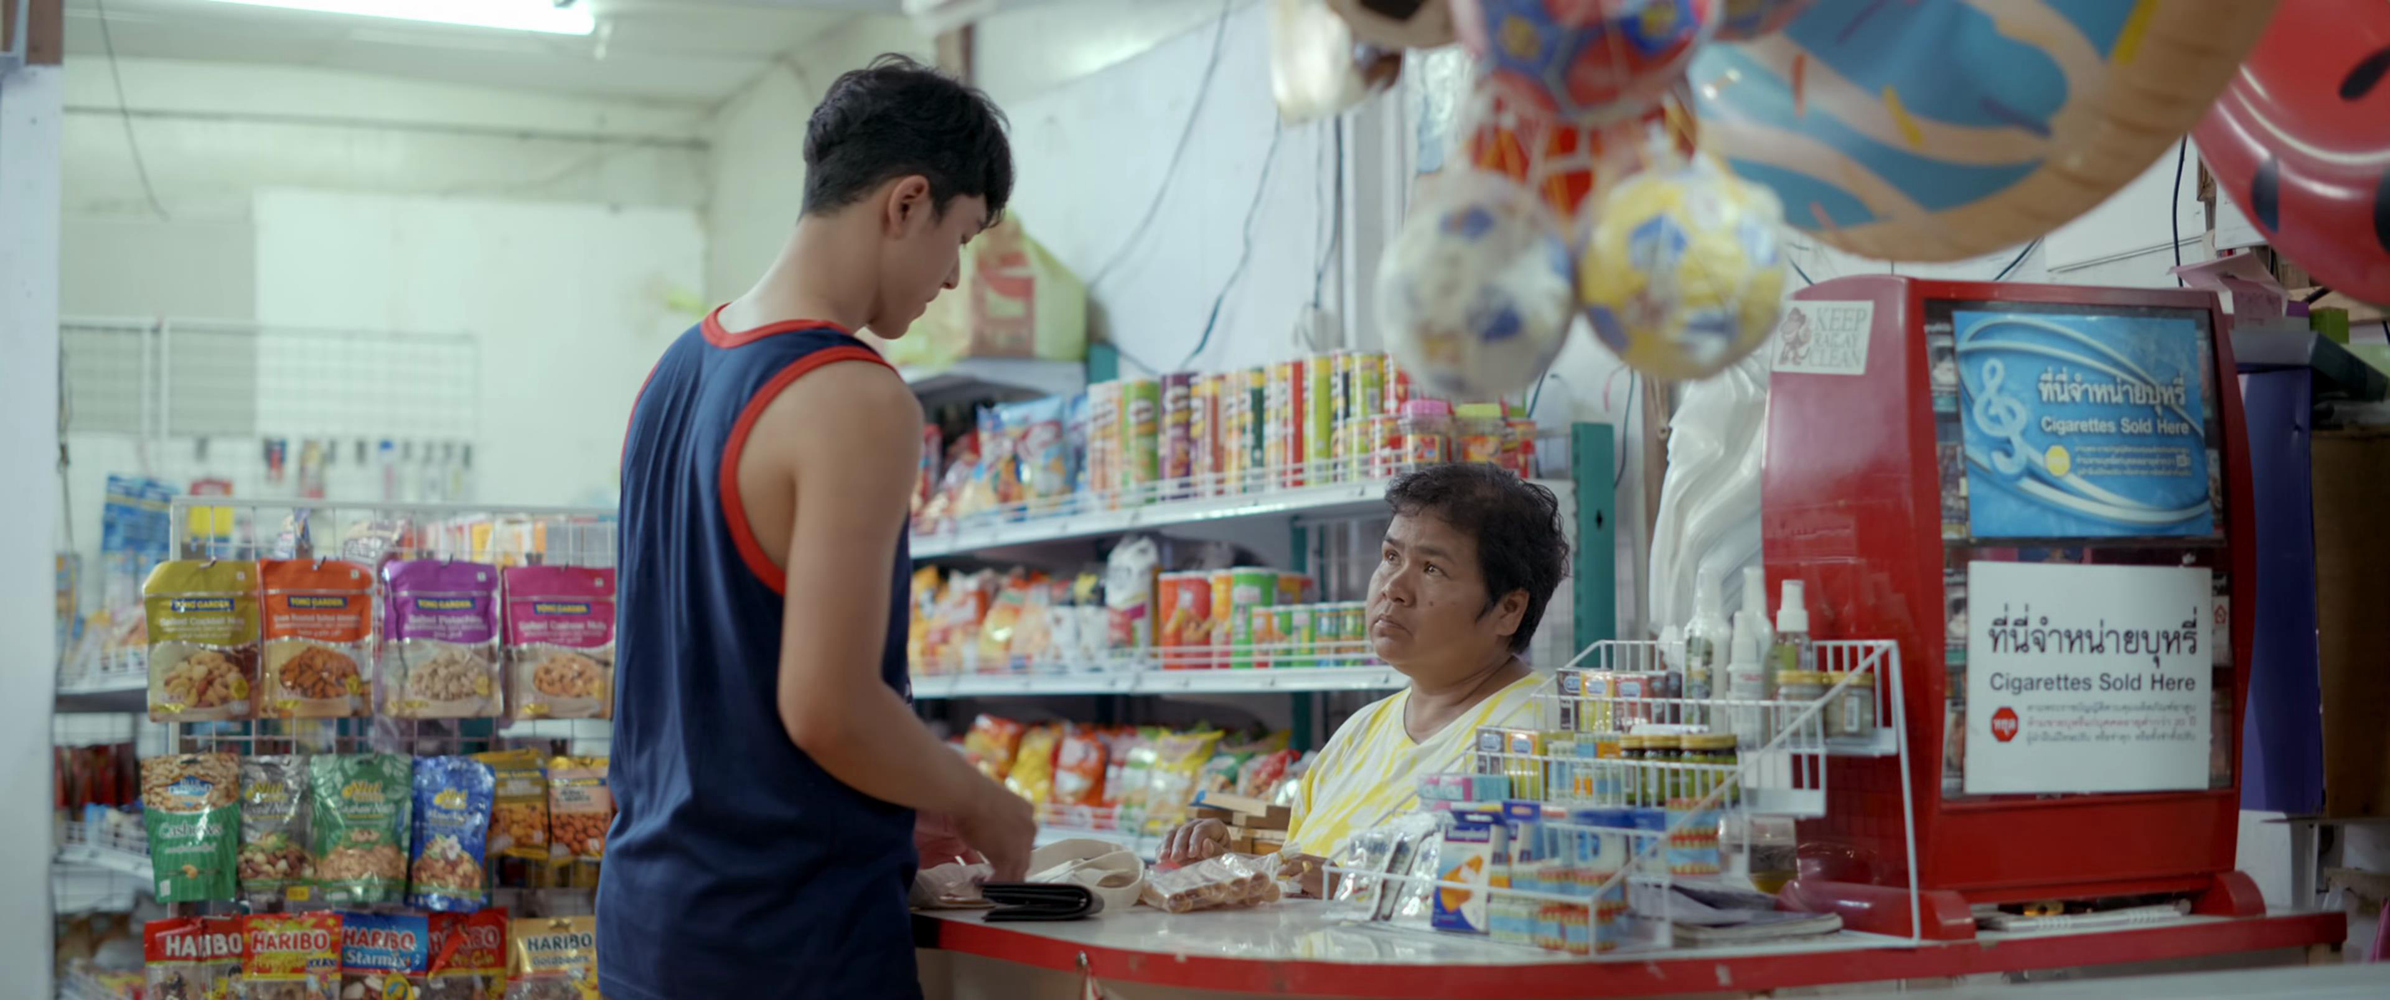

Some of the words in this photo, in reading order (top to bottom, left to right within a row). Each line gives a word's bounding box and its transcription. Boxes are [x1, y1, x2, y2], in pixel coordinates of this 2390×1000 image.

[1815, 307, 1868, 332] KEEP
[1809, 349, 1861, 368] CLEAN
[2038, 366, 2186, 416] ที่นี่จำหน่ายบุหรี่
[2041, 416, 2116, 435] Cigarettes
[2121, 417, 2152, 434] Sold
[2158, 419, 2190, 435] Here
[1988, 602, 2198, 669] ที่นี่จำหน่ายบุหรี่
[1990, 672, 2092, 695] Cigarettes
[2099, 673, 2141, 691] Sold
[2151, 674, 2195, 691] Here
[165, 932, 242, 957] HAIBO
[252, 929, 331, 952] HARIBO
[342, 928, 416, 950] HARIBO
[527, 932, 593, 952] HARIBO
[346, 950, 407, 968] Starmix
